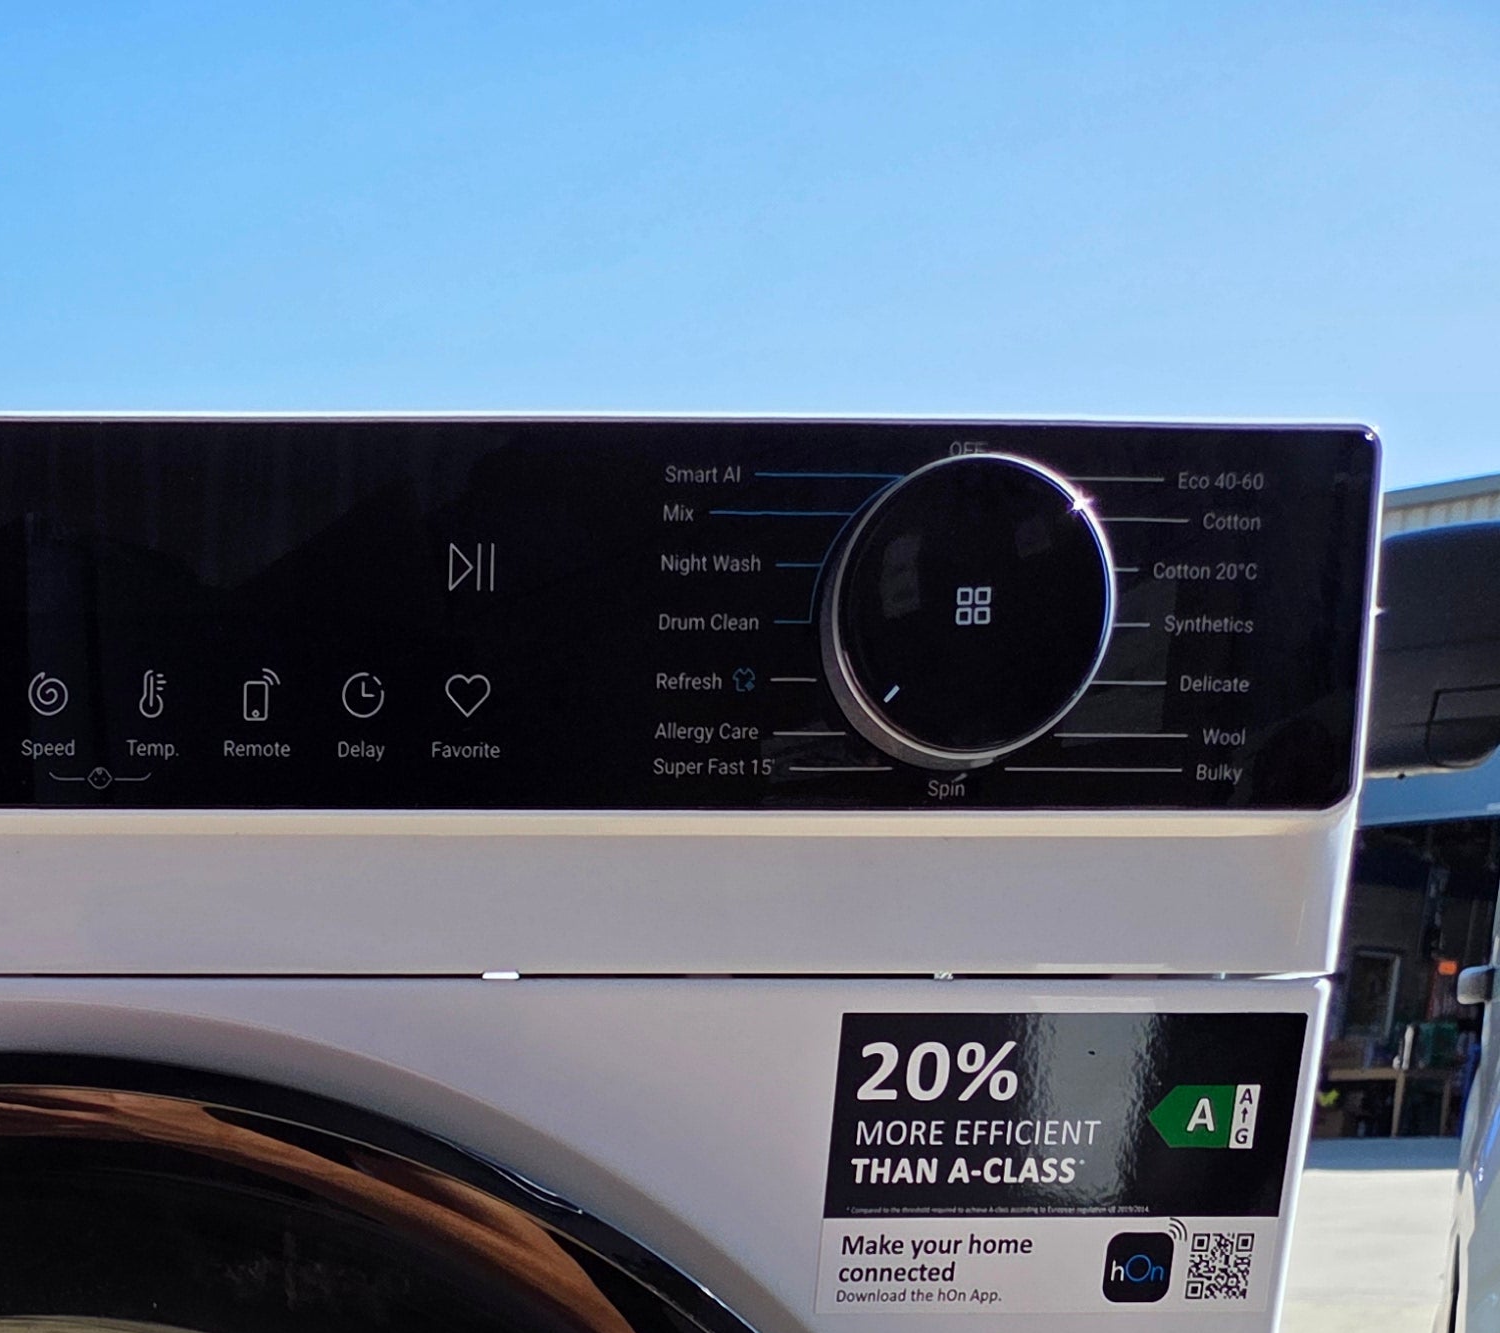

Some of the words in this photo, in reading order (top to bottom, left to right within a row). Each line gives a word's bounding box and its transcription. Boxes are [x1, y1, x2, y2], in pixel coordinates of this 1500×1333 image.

[665, 465, 717, 483] Smart
[722, 465, 741, 483] AI
[1179, 472, 1209, 489] Eco
[1215, 473, 1263, 489] 40-60
[664, 504, 693, 521] Mix
[1203, 513, 1261, 530] Cotton
[661, 554, 707, 575] Night
[713, 555, 760, 571] Wash
[1154, 562, 1210, 579] Cotton
[1216, 563, 1257, 580] 20°C
[659, 614, 704, 630] Drum
[711, 614, 759, 630] Clean
[1164, 615, 1253, 635] Synthetics
[657, 673, 722, 690] Refresh
[1181, 675, 1249, 692] Delicate
[655, 723, 714, 743] Allergy
[719, 723, 758, 739] Care
[1203, 729, 1245, 745] Wool
[22, 739, 74, 759] Speed
[126, 740, 181, 760] Temp.
[224, 740, 290, 757] Remote
[338, 741, 384, 761] Delay
[432, 742, 500, 758] Favorite
[654, 758, 703, 777] Super
[708, 758, 744, 774] Fast
[1196, 764, 1242, 784] Bulky
[927, 780, 965, 800] Spin
[857, 1041, 1018, 1101] 20%
[1240, 1088, 1252, 1104] A
[1187, 1098, 1214, 1131] A
[856, 1121, 944, 1145] MORE
[956, 1120, 1101, 1145] EFFICIENT
[1235, 1128, 1248, 1144] G
[851, 1158, 938, 1183] THAN
[842, 1234, 903, 1255] Make
[911, 1240, 962, 1258] your
[969, 1234, 1032, 1254] home
[838, 1261, 955, 1282] connected
[1111, 1255, 1163, 1281] hOn
[836, 1289, 906, 1302] Download
[911, 1289, 933, 1301] the
[938, 1288, 966, 1301] hOn
[970, 1289, 1001, 1304] App.
